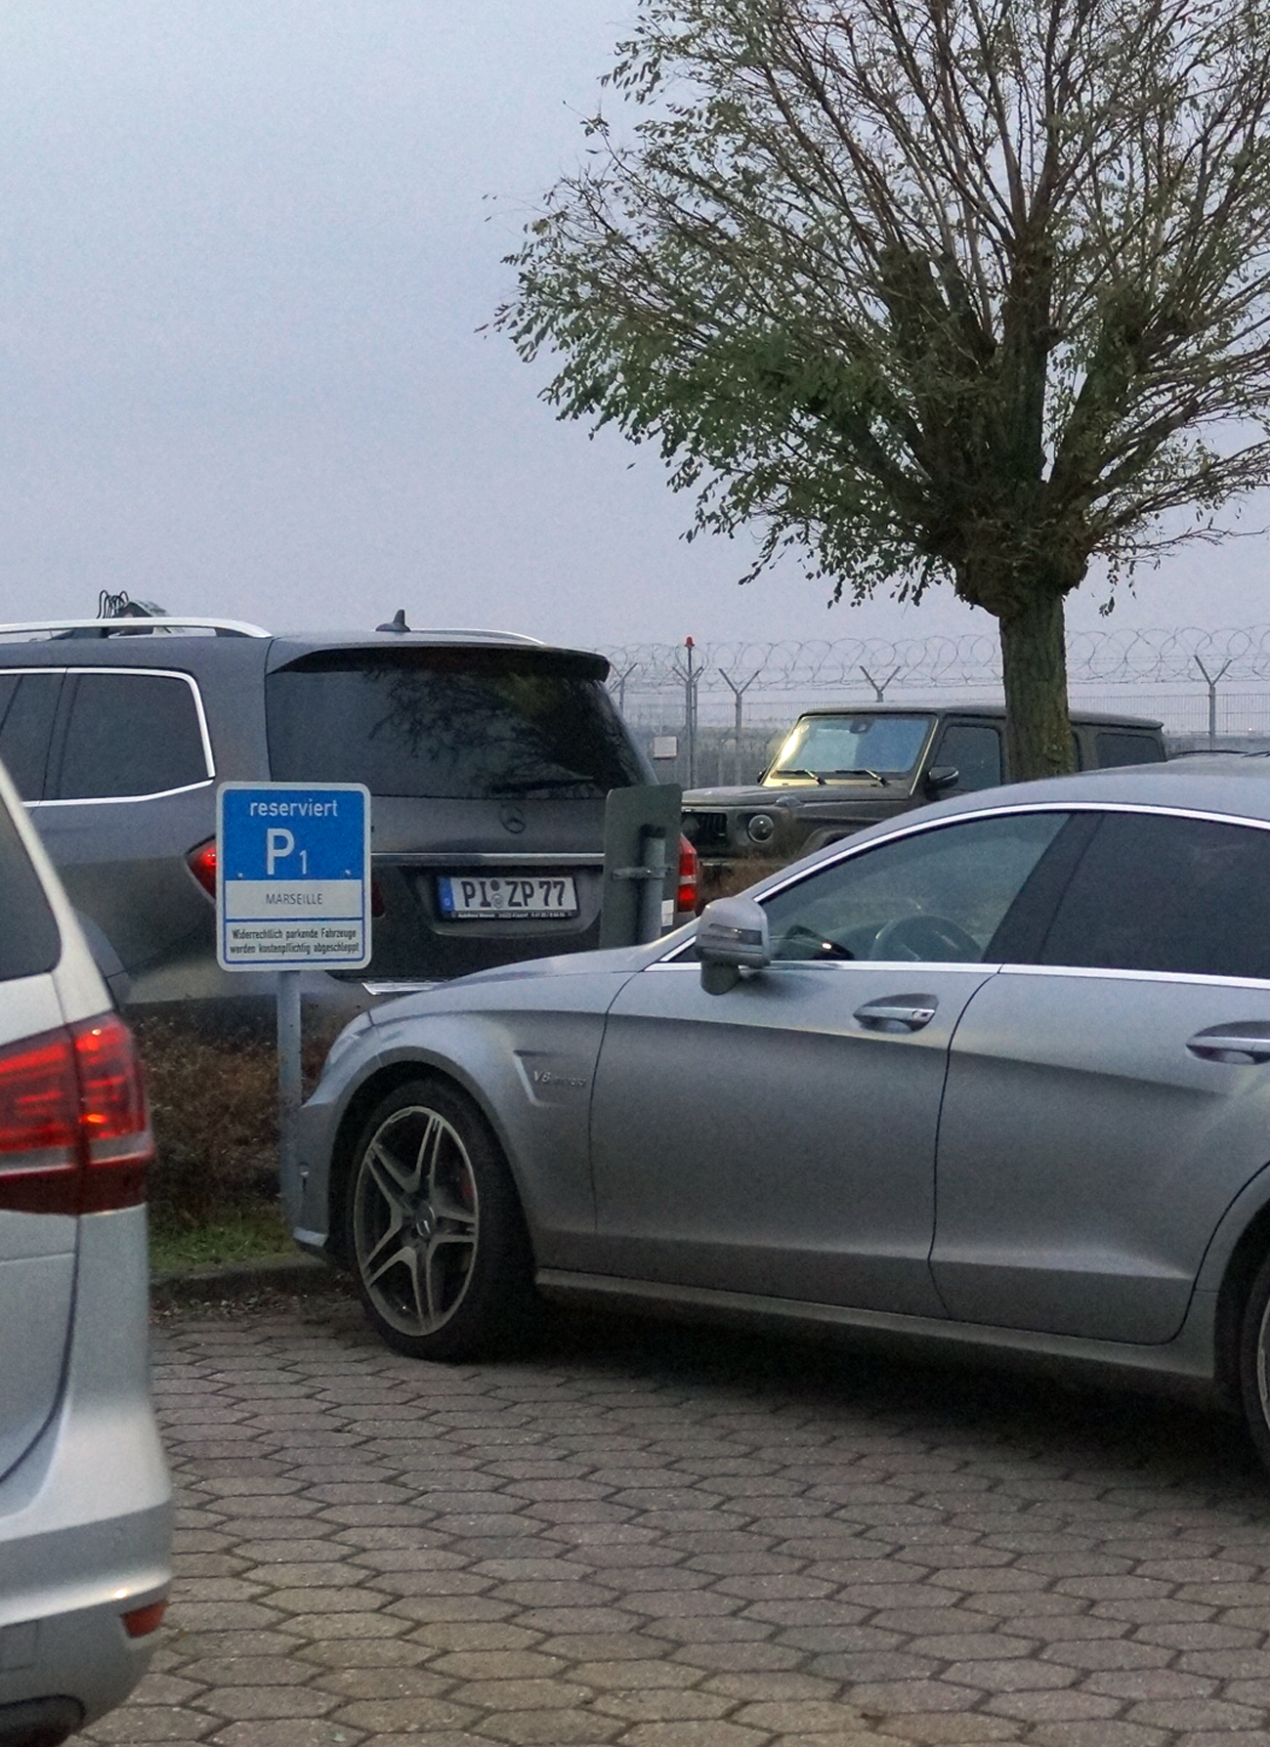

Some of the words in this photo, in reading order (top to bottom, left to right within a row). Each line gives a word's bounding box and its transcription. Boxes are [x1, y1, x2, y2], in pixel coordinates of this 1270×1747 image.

[250, 799, 338, 817] reserviert
[265, 894, 323, 905] MARSEILLE
[460, 880, 492, 908] PI
[504, 880, 535, 907] ZP
[538, 880, 565, 907] 77
[232, 929, 283, 940] Widerrechtlich
[286, 929, 318, 941] parkende
[321, 928, 357, 940] Fahrzeuge
[229, 943, 256, 954] werden
[258, 942, 311, 955] kostenpflichtig
[313, 942, 360, 955] abgeschleppt
